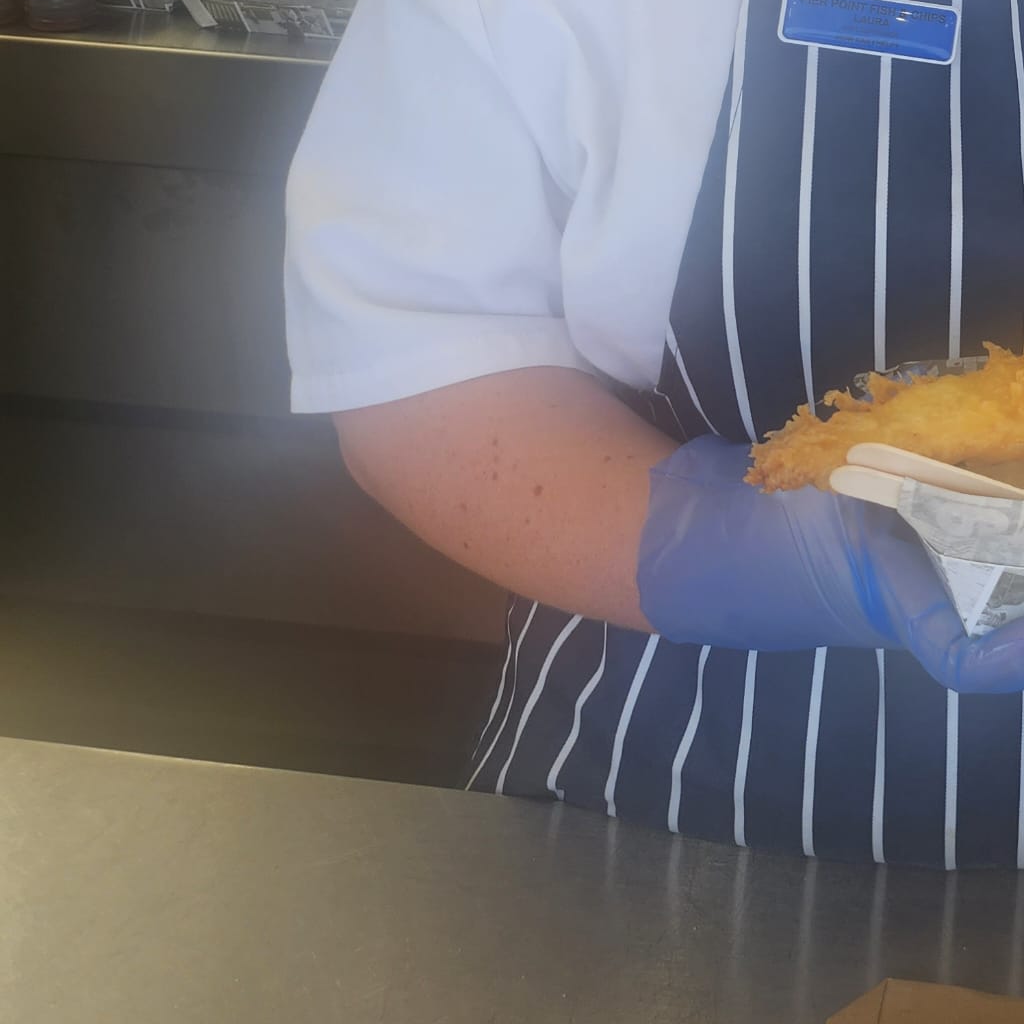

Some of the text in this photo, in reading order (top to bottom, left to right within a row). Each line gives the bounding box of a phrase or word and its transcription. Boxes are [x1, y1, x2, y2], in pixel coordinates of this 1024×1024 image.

[853, 14, 890, 27] LAURA
[869, 4, 896, 17] FISH
[911, 9, 948, 25] CHIPS
